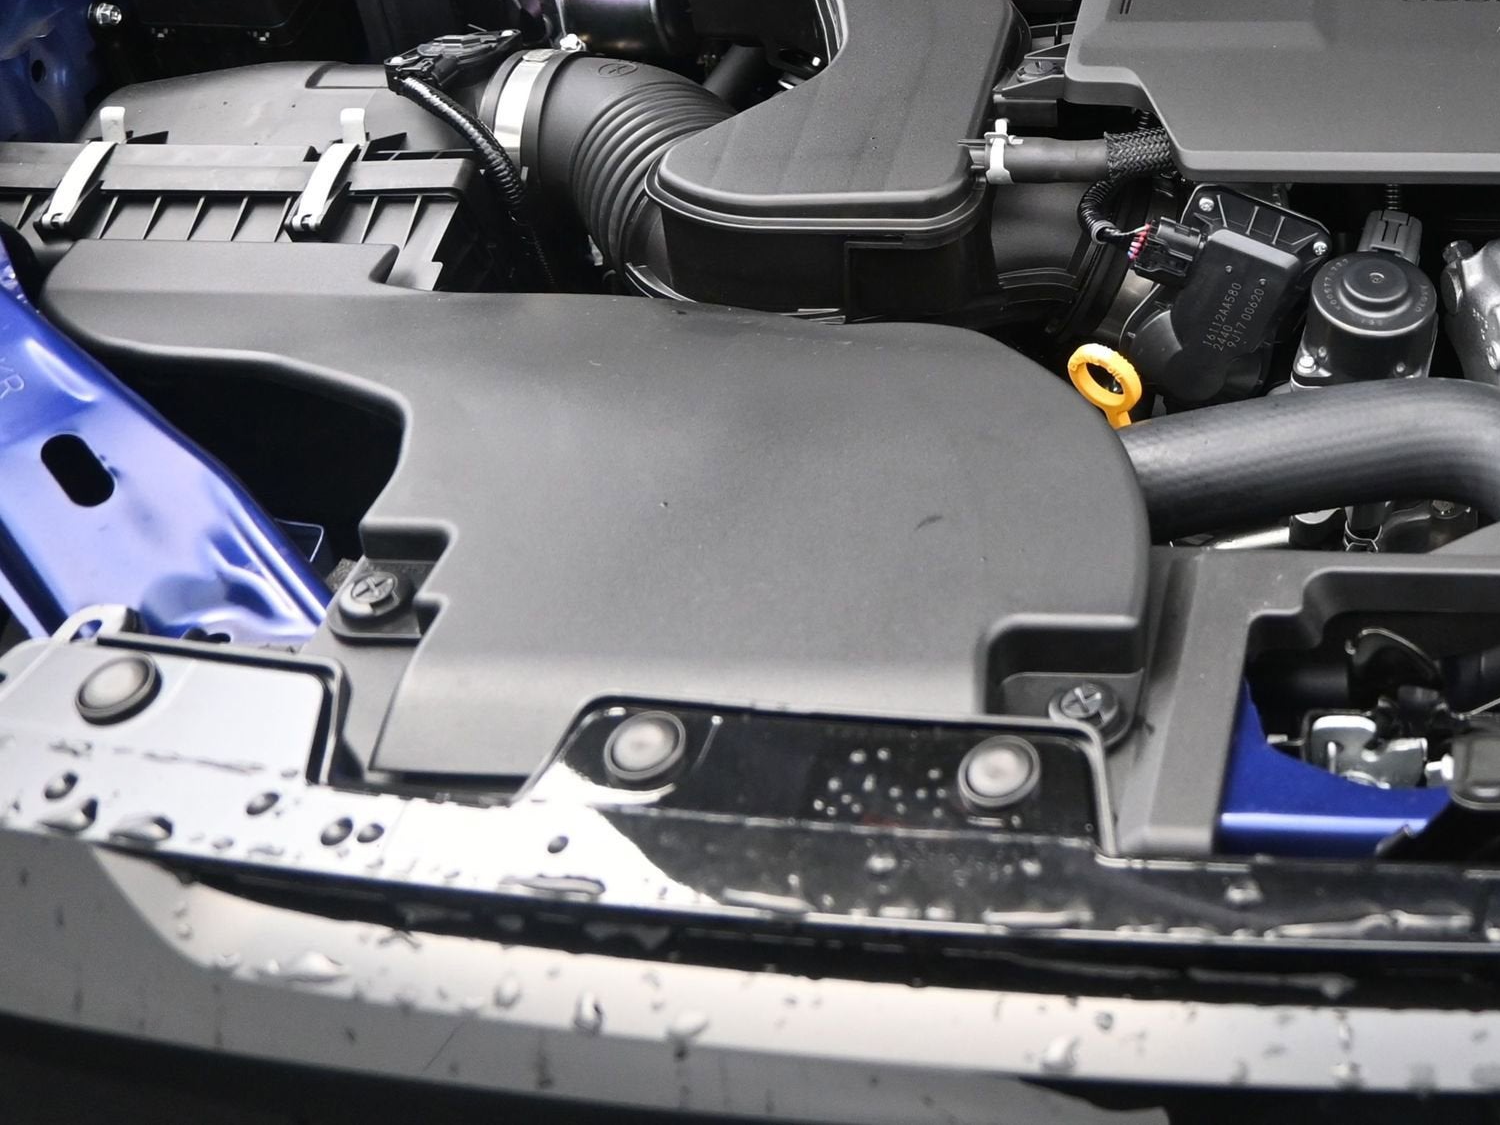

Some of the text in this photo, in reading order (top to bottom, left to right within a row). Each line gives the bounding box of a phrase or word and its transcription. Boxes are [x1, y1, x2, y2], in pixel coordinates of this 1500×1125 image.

[1202, 282, 1242, 346] 16112AA580
[1241, 288, 1265, 321] 00620
[1213, 324, 1233, 351] 2440
